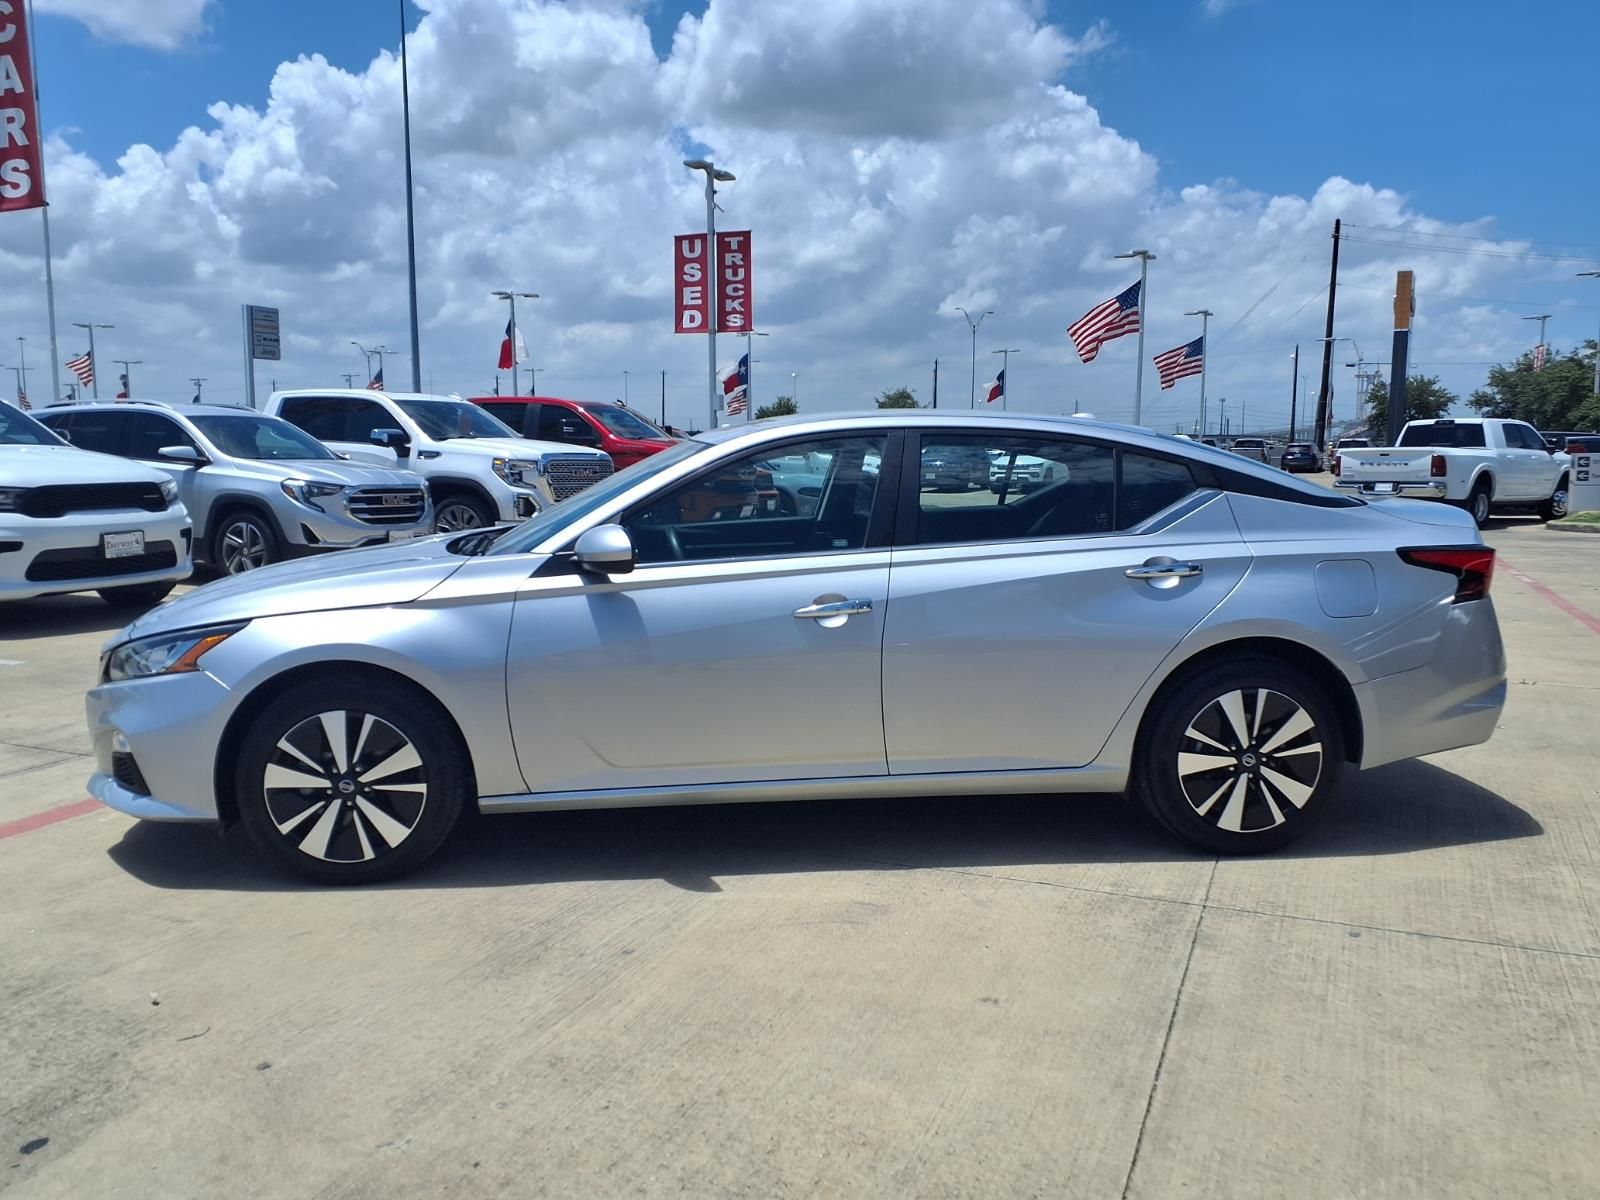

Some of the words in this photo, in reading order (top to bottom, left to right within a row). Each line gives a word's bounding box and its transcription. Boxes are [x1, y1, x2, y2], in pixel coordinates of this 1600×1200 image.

[682, 238, 702, 329] USED
[724, 236, 745, 327] TRUCKS
[382, 495, 410, 506] GMC
